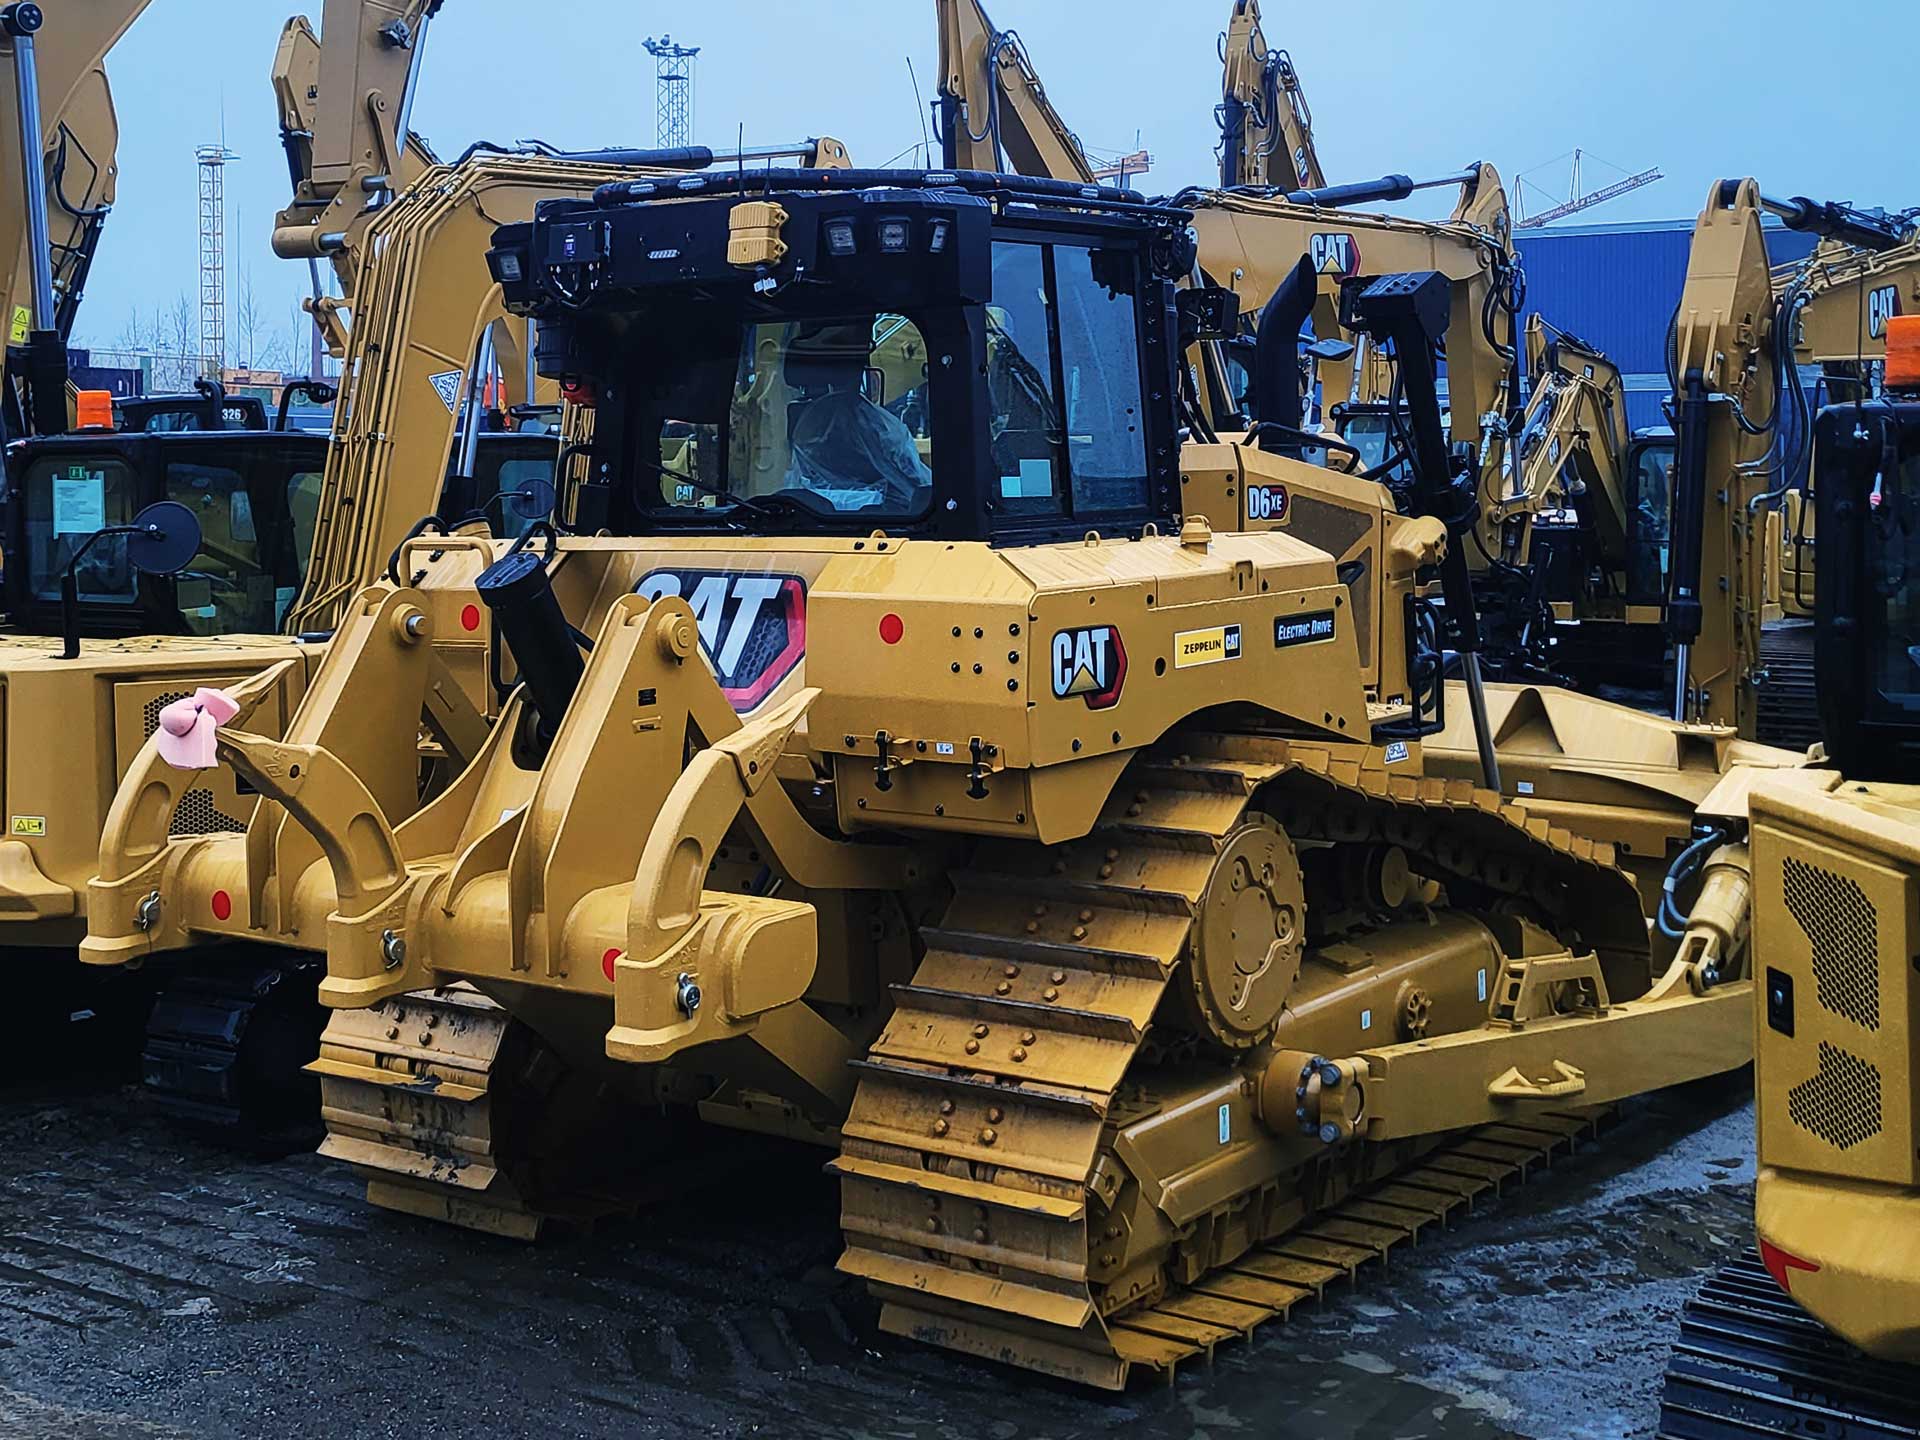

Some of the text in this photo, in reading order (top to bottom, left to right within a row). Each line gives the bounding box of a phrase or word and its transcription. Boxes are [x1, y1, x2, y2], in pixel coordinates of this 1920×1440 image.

[1311, 234, 1349, 273] CAT
[1869, 287, 1895, 337] CAT
[222, 408, 242, 420] 326
[676, 485, 695, 501] CAT
[635, 573, 783, 678] AT
[1278, 620, 1333, 640] ELECTRIC DRIVE
[1183, 633, 1239, 655] ZEPPELIN CAT
[1053, 628, 1110, 696] CAT
